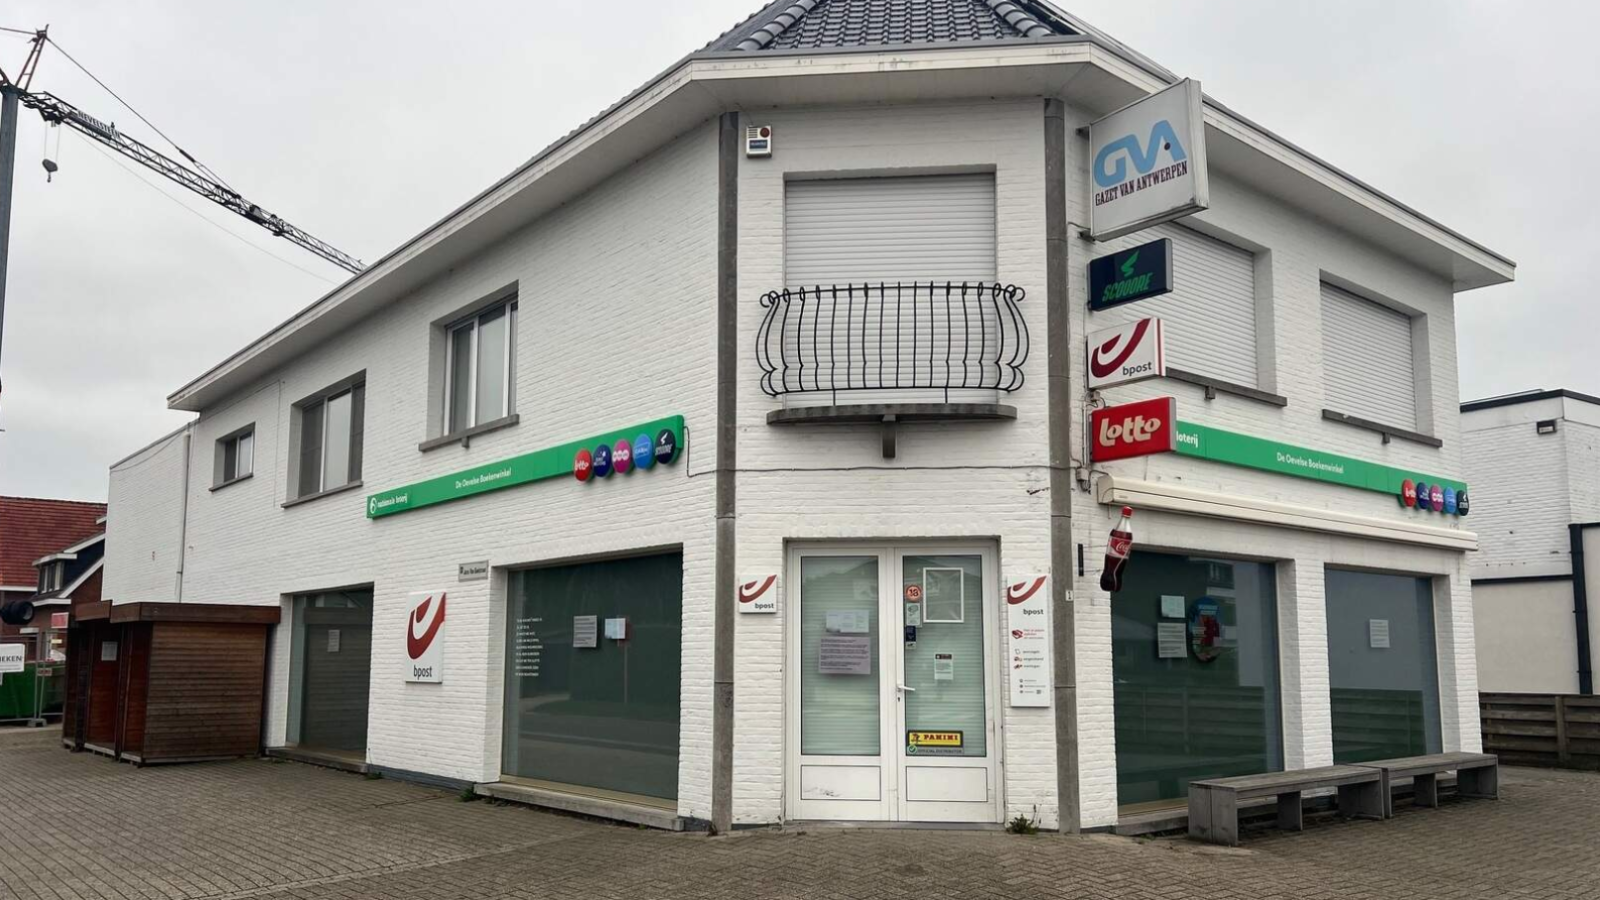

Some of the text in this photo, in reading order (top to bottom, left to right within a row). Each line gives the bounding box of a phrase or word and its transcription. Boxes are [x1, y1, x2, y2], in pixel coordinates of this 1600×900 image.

[1093, 119, 1187, 188] GVA
[1095, 161, 1188, 206] GAZET VAN ANTWERPEN
[1122, 361, 1153, 377] bpost
[1099, 415, 1162, 447] lotto
[1176, 430, 1199, 448] loterij
[1276, 452, 1345, 474] De Oevelse Boekenwinkel
[455, 480, 461, 489] De
[480, 467, 512, 482] Boekenwinkel
[754, 602, 774, 610] bpost
[1023, 608, 1044, 616] bpost
[413, 665, 433, 680] bpost
